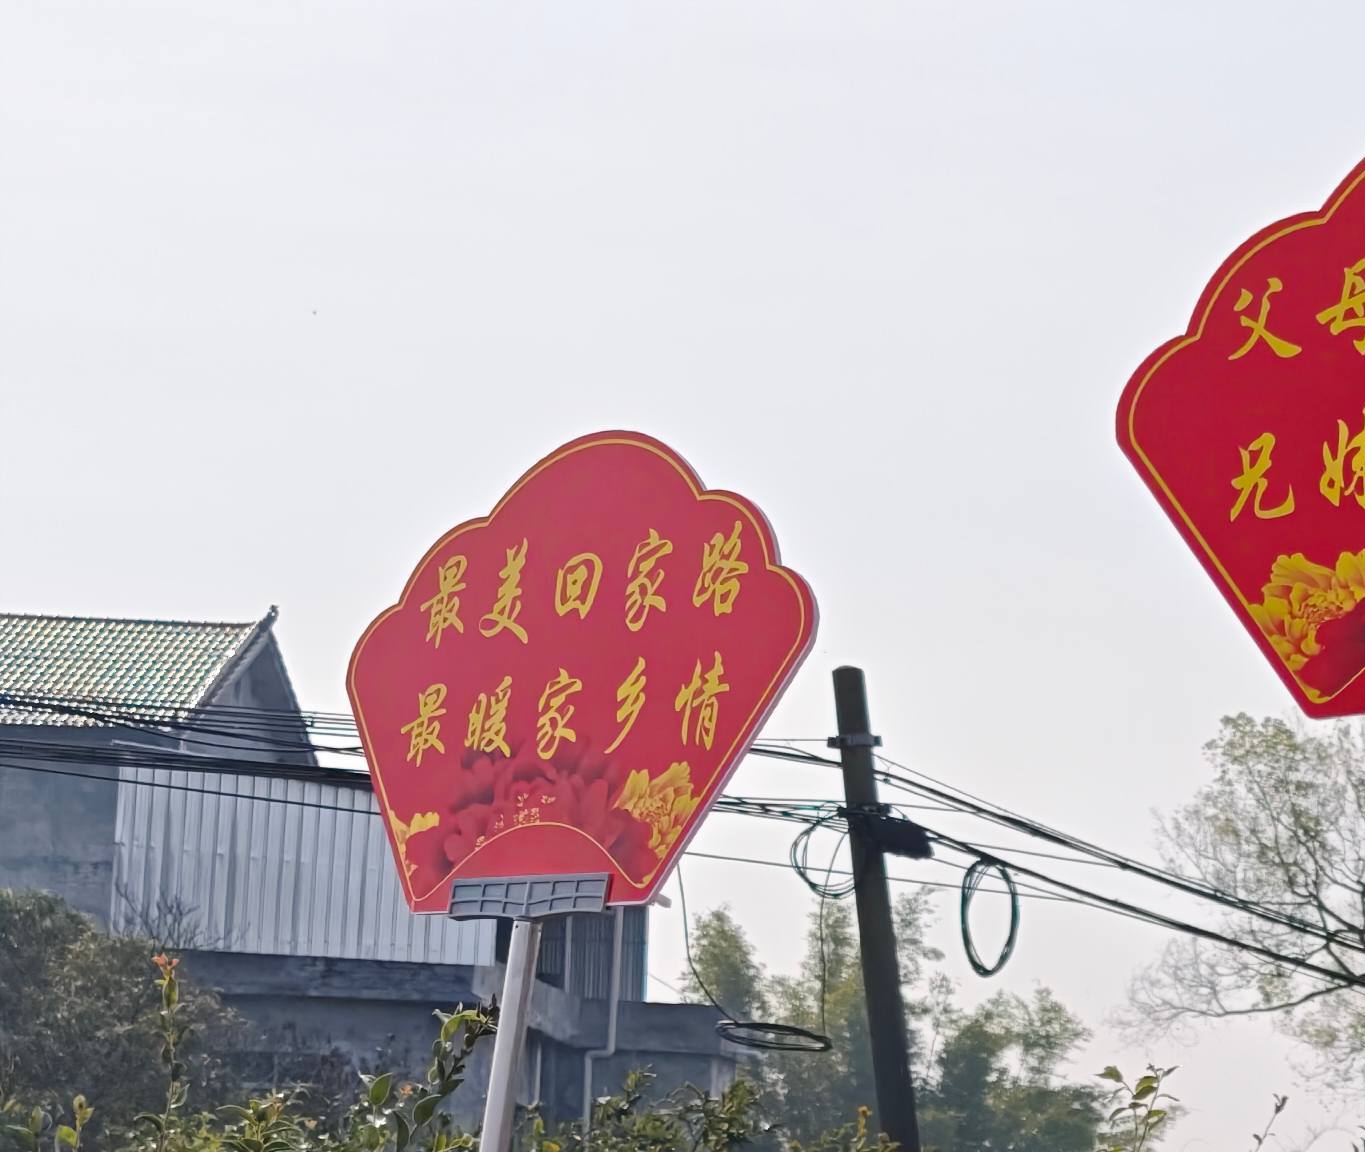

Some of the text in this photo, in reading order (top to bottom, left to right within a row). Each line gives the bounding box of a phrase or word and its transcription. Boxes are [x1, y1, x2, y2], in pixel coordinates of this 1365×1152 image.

[420, 521, 749, 648] 最美回家路
[400, 651, 730, 767] 最暖家乡情
